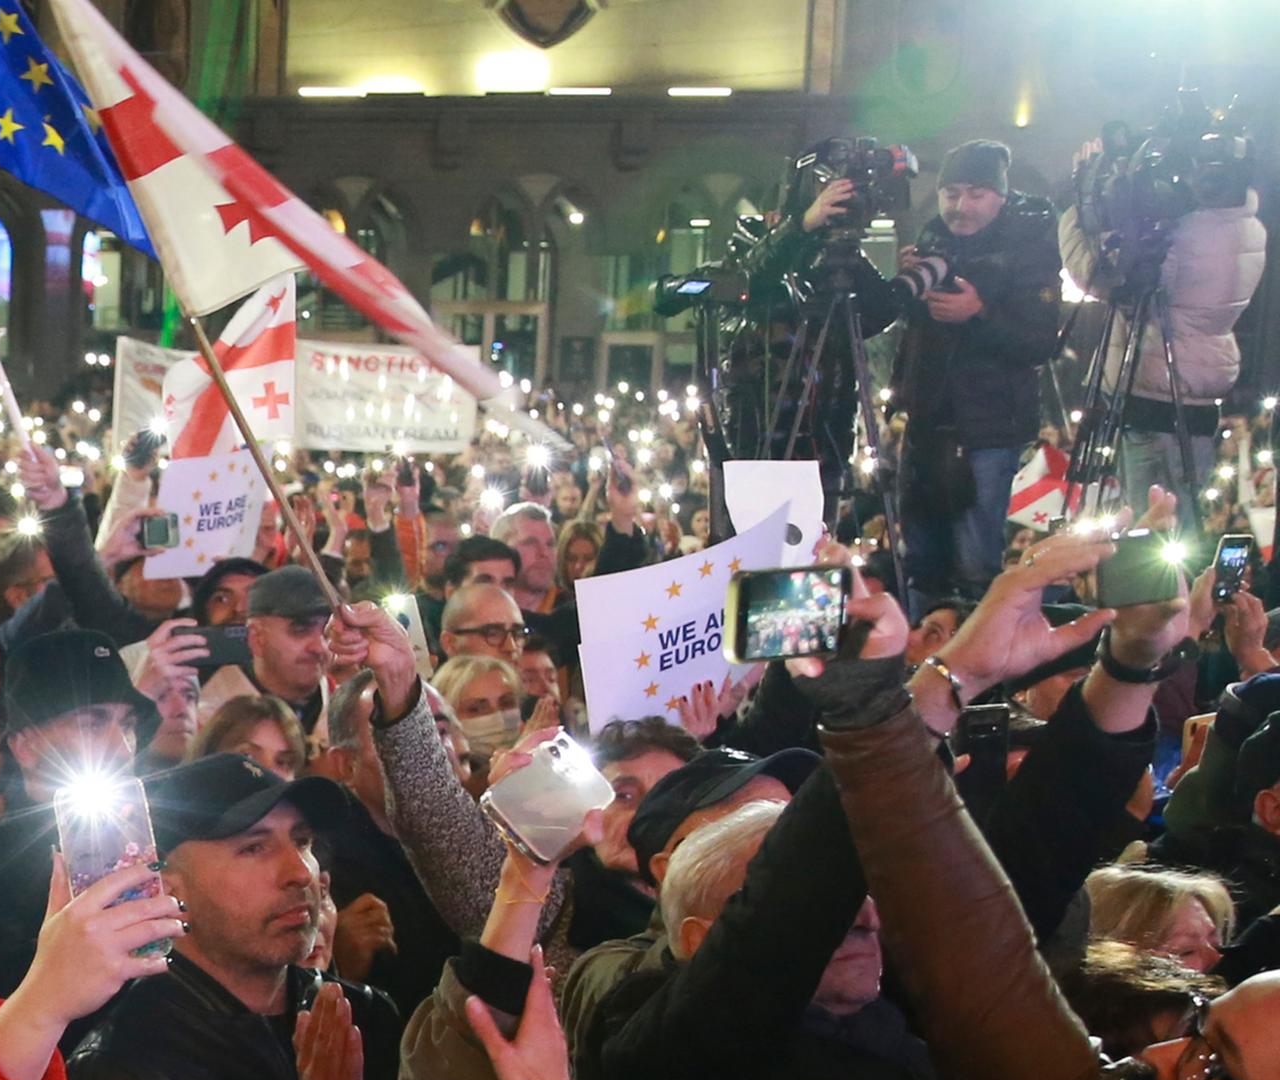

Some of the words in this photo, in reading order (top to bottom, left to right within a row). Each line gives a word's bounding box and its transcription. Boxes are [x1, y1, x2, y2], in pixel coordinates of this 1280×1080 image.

[200, 501, 222, 517] WE
[225, 494, 248, 514] ARE
[658, 620, 696, 650] WE
